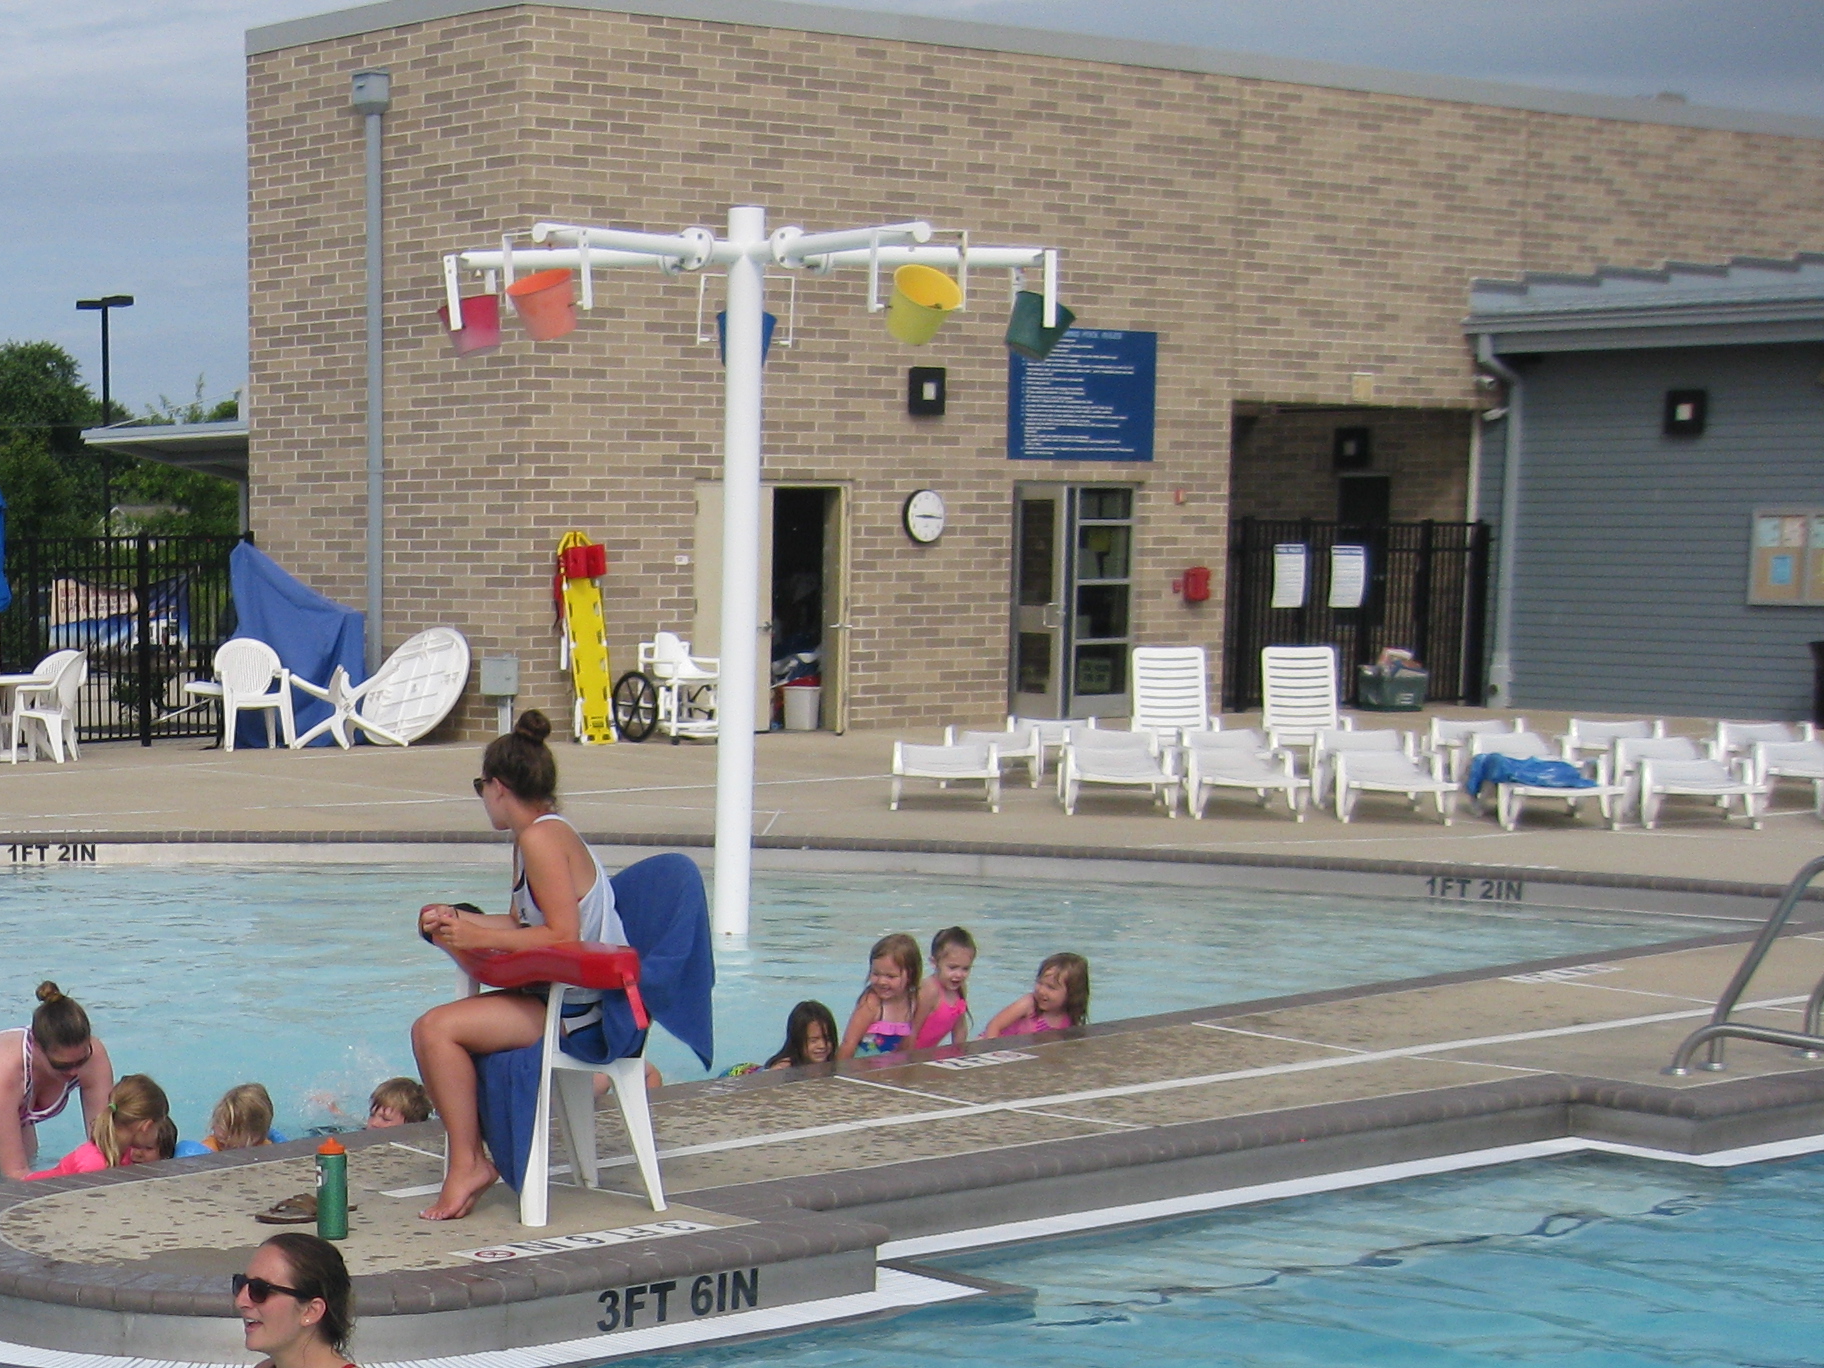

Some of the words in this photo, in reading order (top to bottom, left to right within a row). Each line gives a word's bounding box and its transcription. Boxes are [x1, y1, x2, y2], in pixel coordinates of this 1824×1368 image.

[7, 844, 50, 862] 1FT
[57, 844, 97, 862] 2IN
[1426, 876, 1472, 897] 1FT
[1479, 879, 1523, 901] 2IN
[655, 1222, 697, 1231] 3
[596, 1280, 677, 1332] 3FT
[690, 1267, 759, 1316] 6IN
